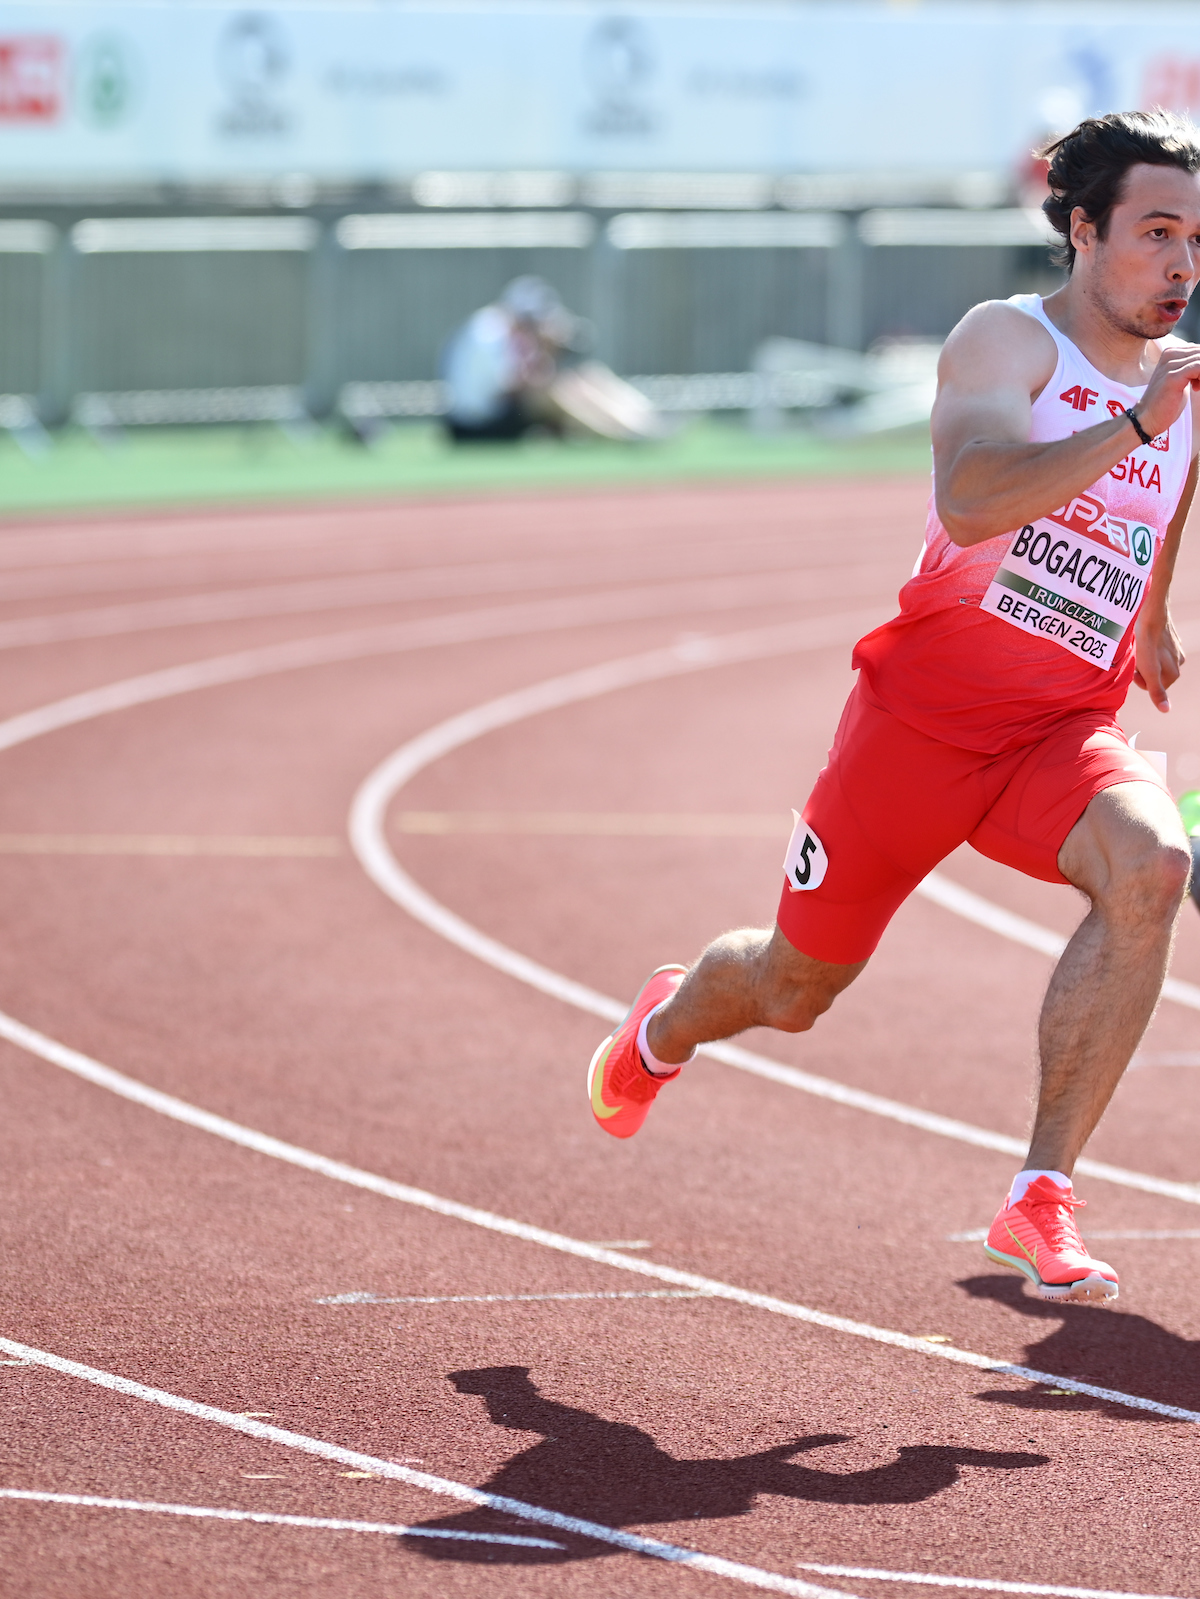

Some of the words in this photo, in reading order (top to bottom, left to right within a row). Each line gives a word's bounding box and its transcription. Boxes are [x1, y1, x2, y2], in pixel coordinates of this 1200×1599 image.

[1059, 385, 1099, 411] 4F
[1052, 497, 1128, 552] PAR
[1011, 524, 1143, 613] BOGACZYNSKI
[1027, 585, 1036, 596] I
[997, 594, 1072, 638] BERGEN
[1068, 630, 1107, 659] 2025
[795, 833, 817, 885] 5
